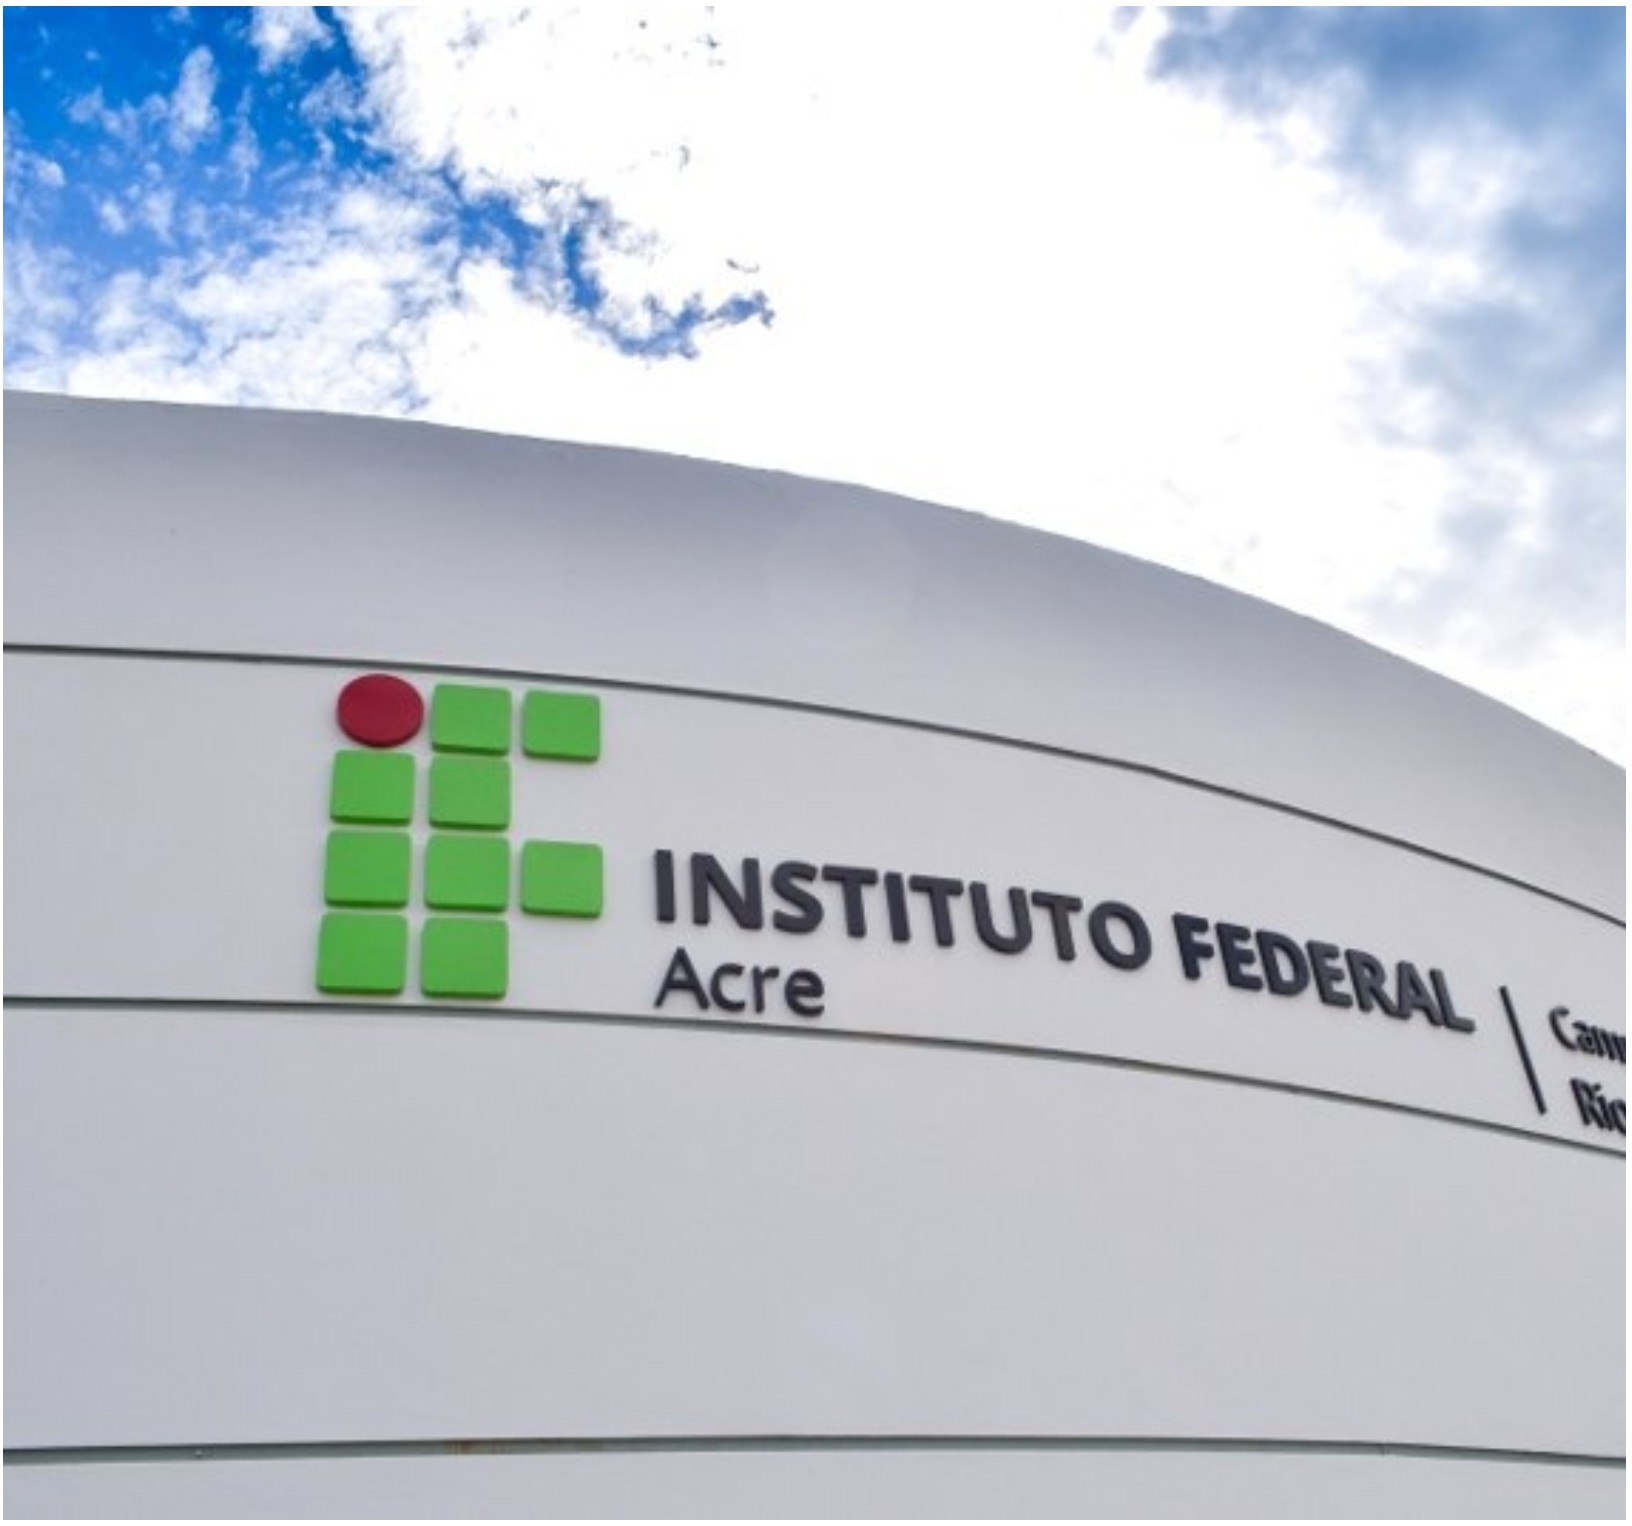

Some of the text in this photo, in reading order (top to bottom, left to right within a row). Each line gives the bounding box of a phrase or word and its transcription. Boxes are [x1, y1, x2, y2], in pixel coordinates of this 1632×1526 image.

[653, 848, 1477, 1035] INSTITUTO FEDERAL
[653, 946, 826, 1020] Acre
